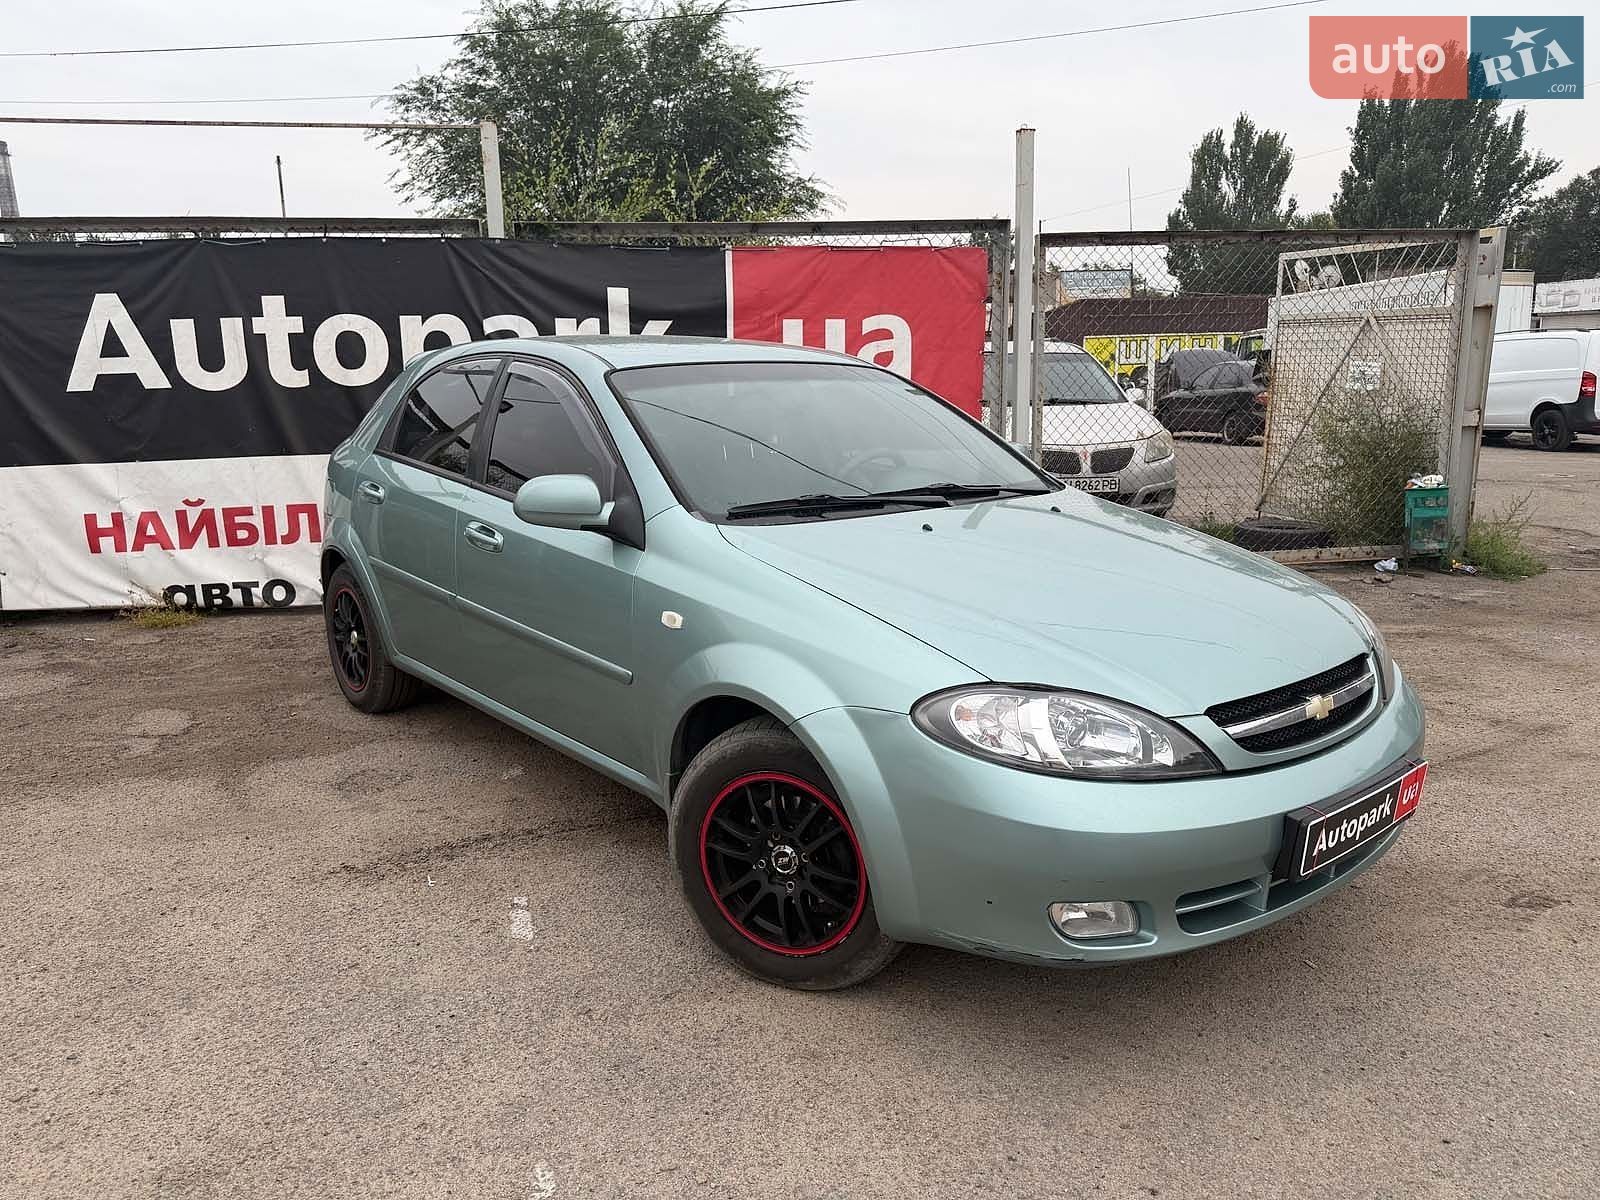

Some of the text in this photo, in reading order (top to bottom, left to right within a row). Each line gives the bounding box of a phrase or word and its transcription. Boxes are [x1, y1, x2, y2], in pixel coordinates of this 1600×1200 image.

[84, 498, 322, 554] НАЙБІЛ
[1312, 782, 1419, 857] Autopark ua
